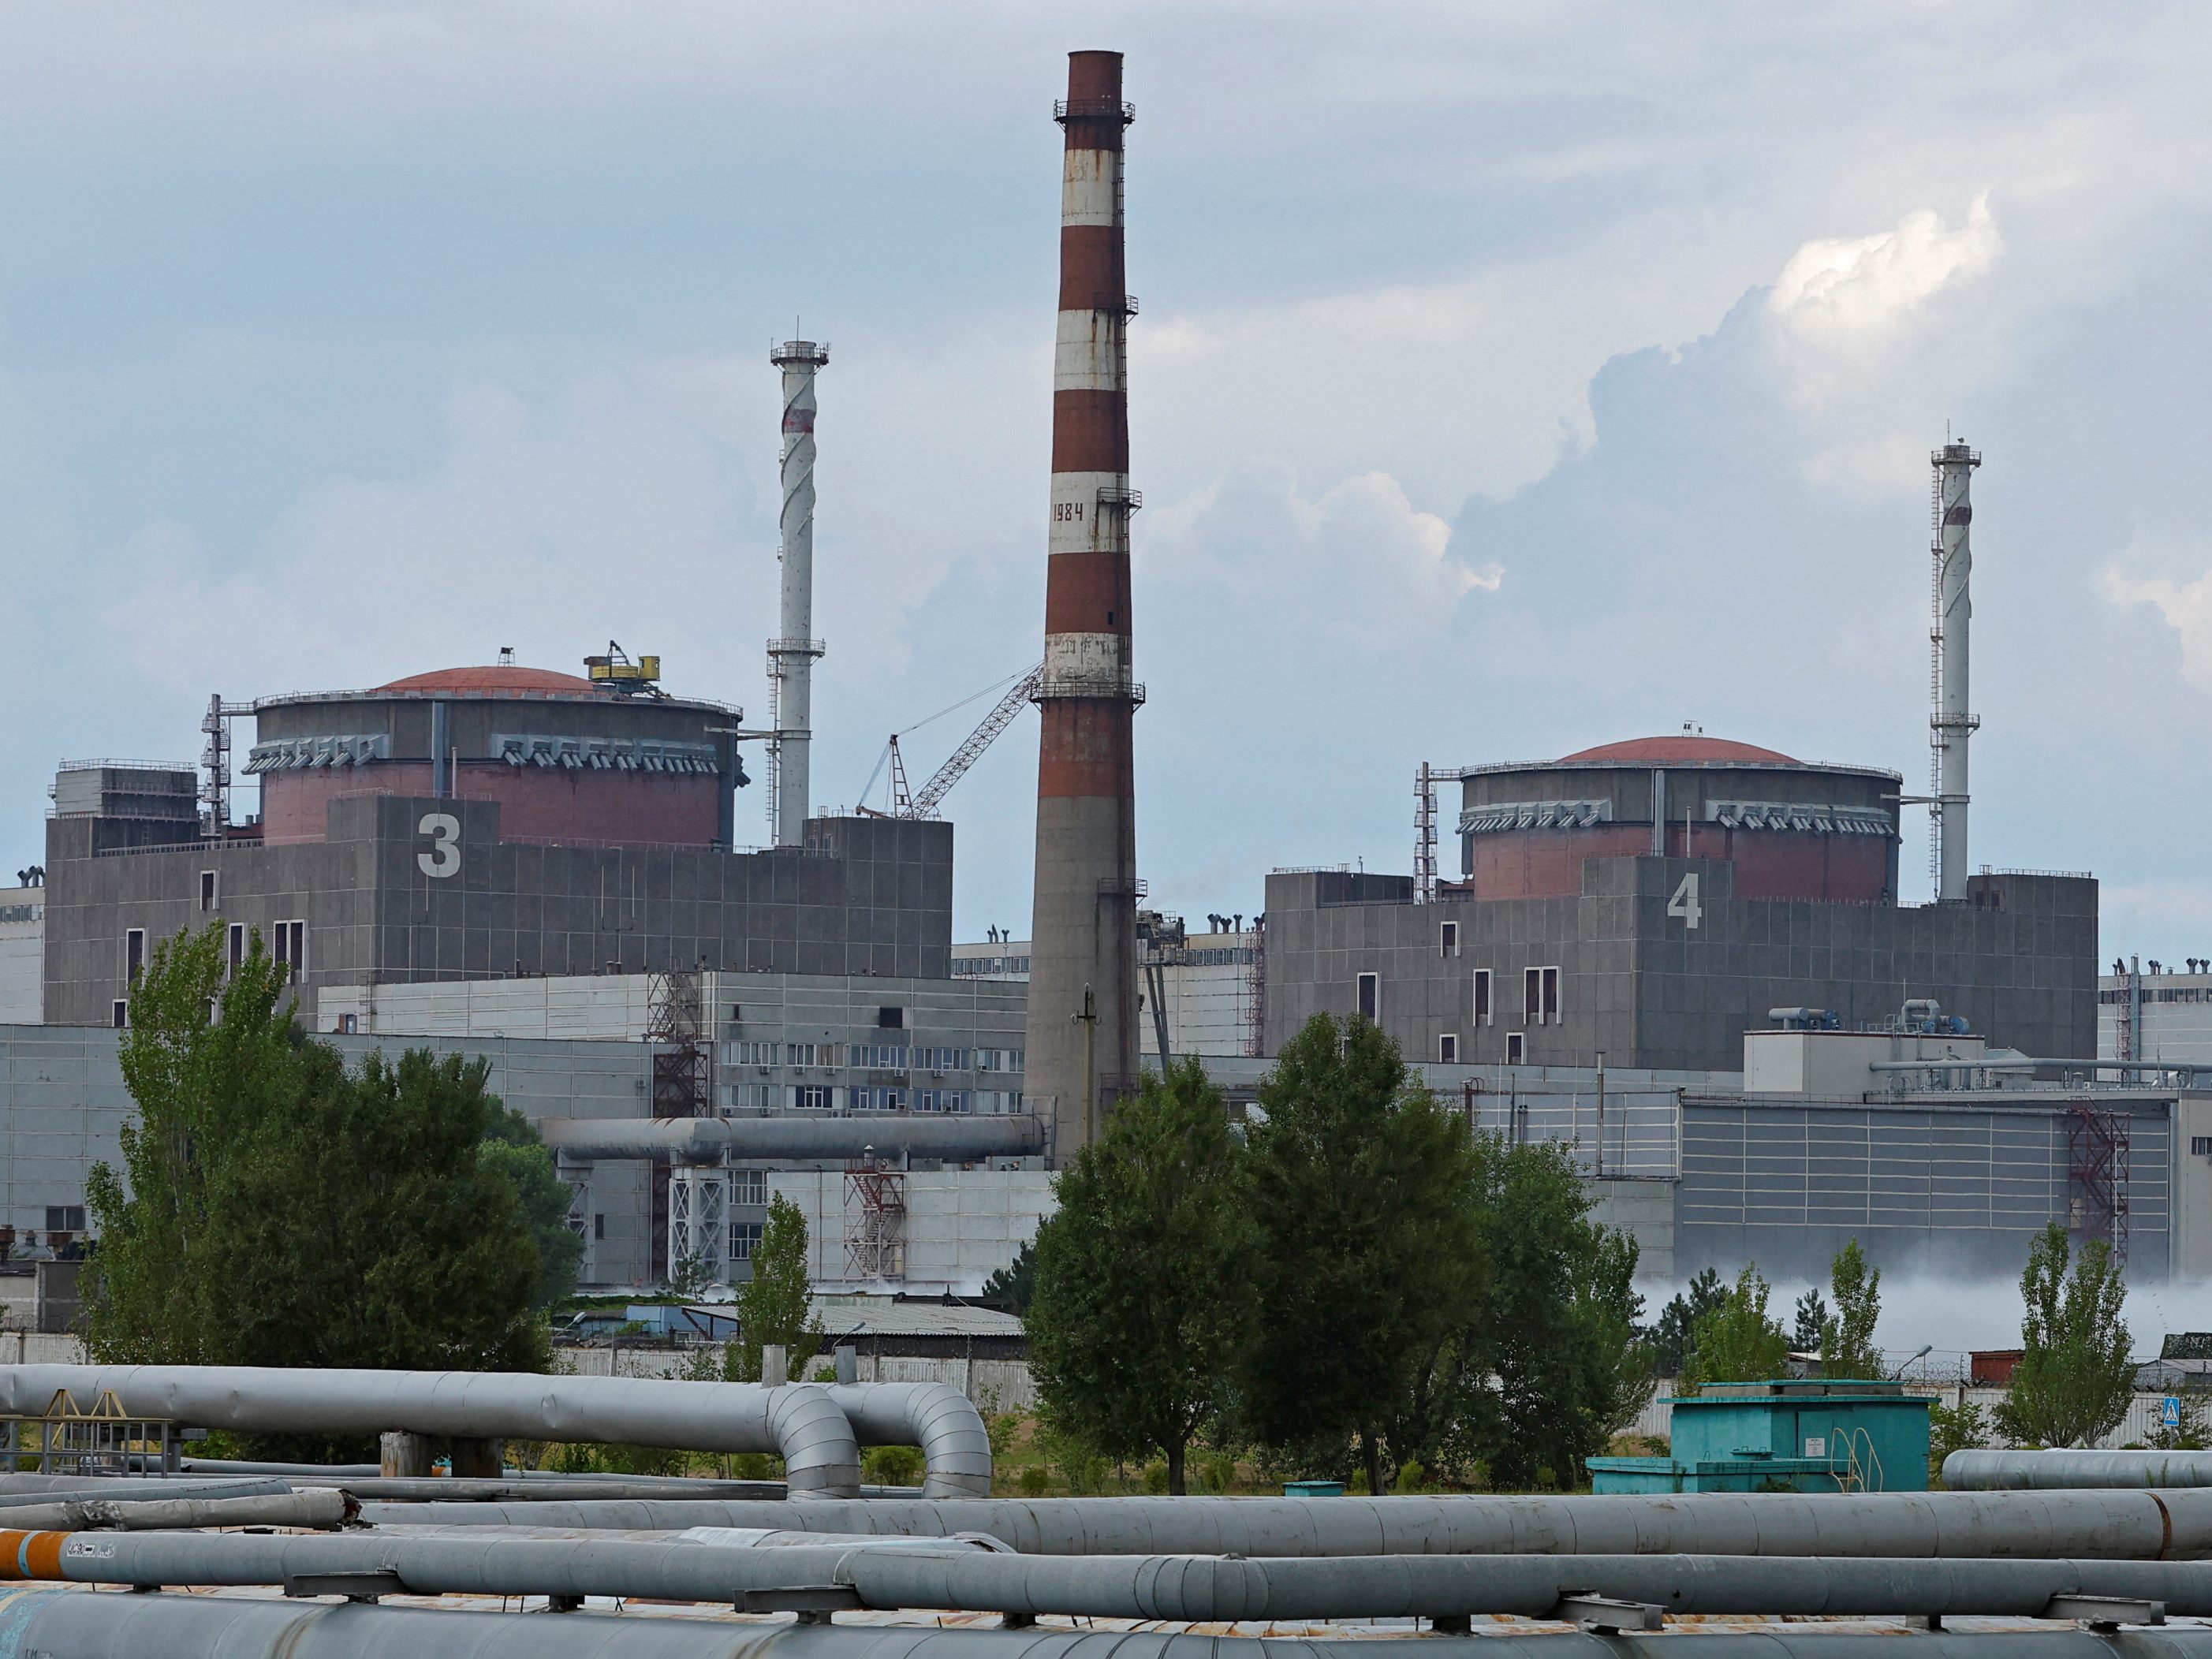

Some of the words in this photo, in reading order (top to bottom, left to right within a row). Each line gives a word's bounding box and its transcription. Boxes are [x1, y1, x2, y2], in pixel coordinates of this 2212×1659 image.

[1054, 502, 1084, 522] 1984
[417, 813, 461, 878] 3
[1667, 873, 1702, 929] 4
